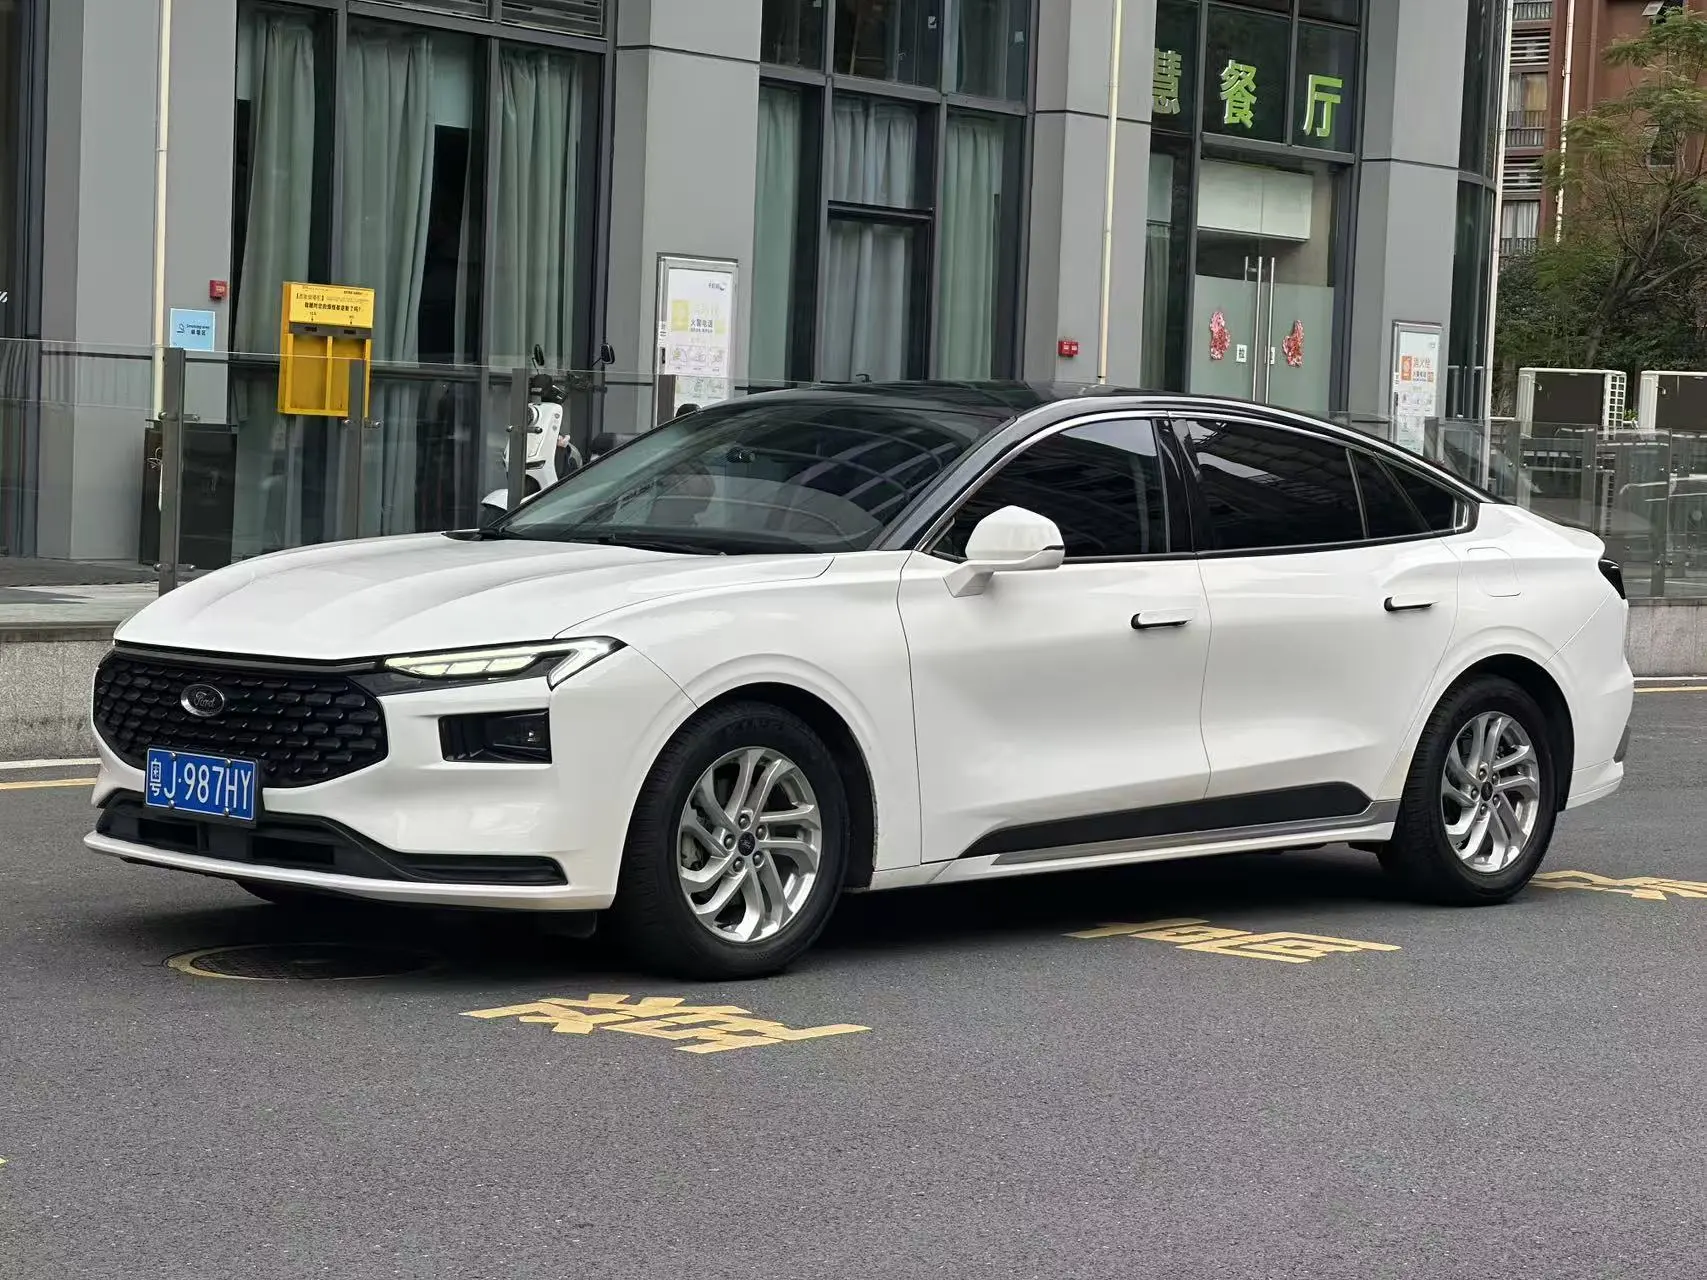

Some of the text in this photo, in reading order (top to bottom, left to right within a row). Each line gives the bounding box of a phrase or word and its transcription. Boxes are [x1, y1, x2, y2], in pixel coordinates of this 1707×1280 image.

[1152, 48, 1343, 137] 慧餐厅
[194, 691, 216, 708] Ford
